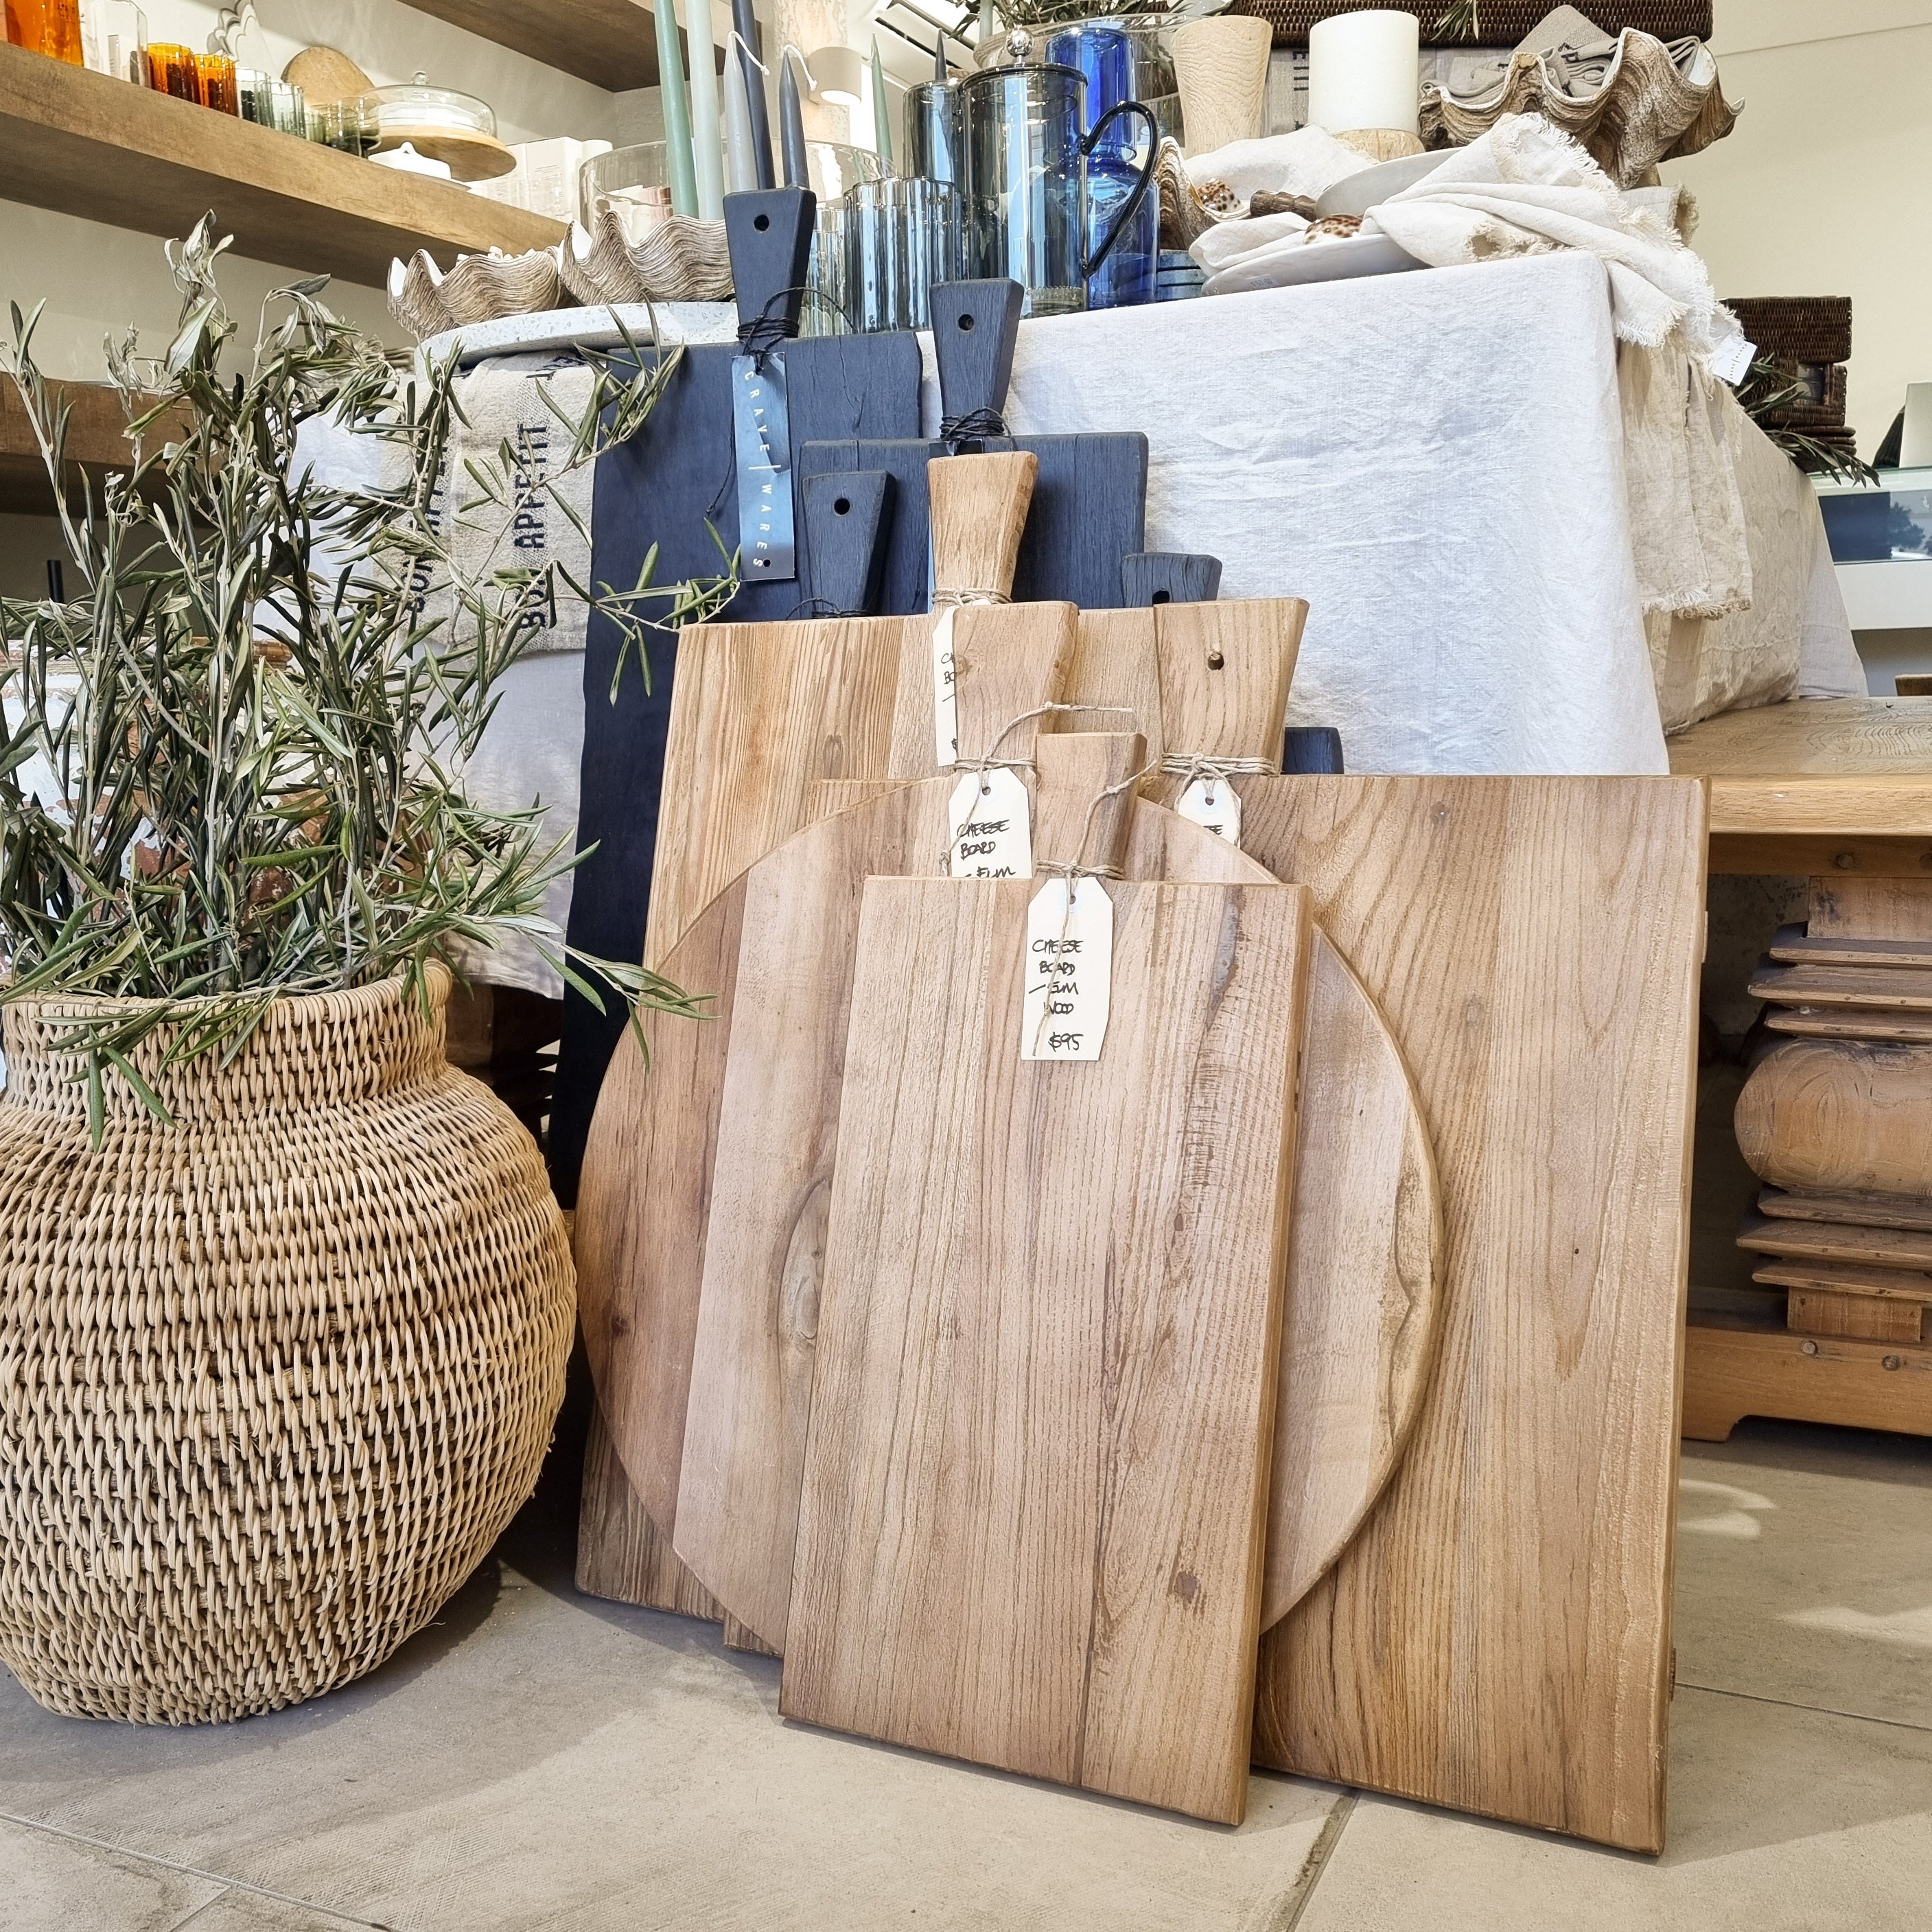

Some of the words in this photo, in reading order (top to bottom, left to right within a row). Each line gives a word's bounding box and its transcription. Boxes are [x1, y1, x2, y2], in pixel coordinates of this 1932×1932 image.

[745, 370, 769, 452] CRAVE
[753, 484, 772, 568] WARES
[1048, 1032, 1084, 1052] $95
